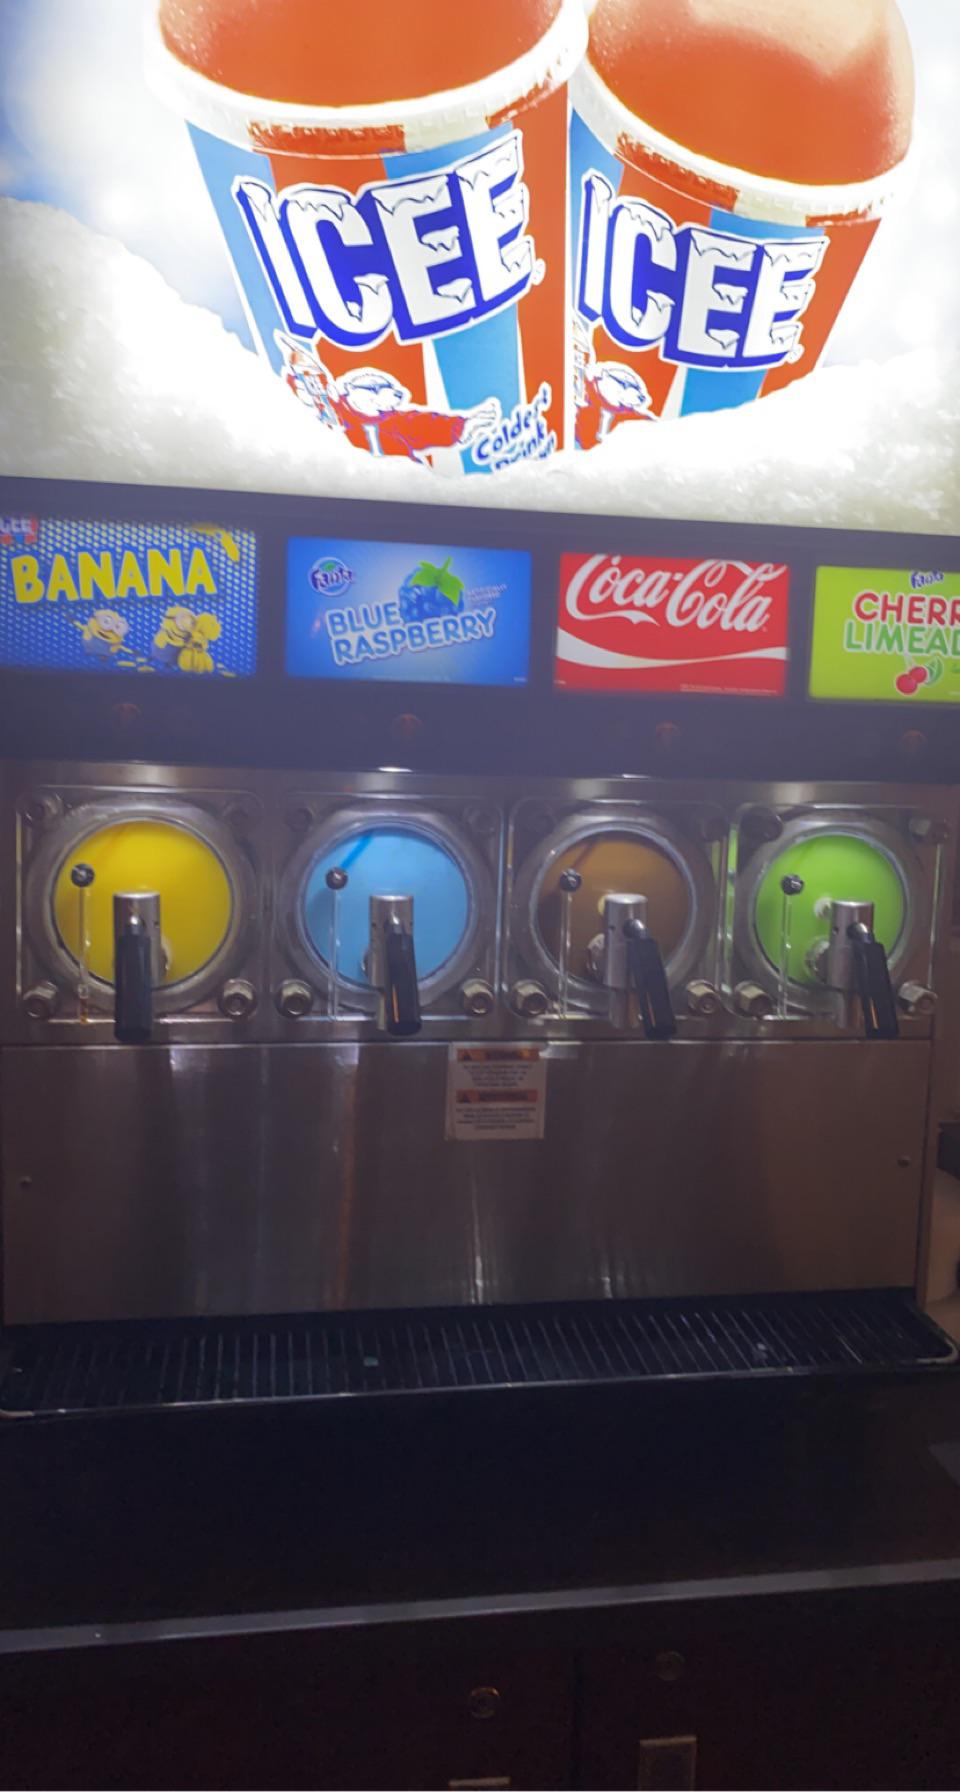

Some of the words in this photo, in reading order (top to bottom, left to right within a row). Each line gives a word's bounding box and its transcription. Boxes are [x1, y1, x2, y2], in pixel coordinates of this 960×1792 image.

[235, 133, 533, 346] ICEE
[577, 174, 825, 367] ICEE
[11, 548, 217, 603] BANANA
[310, 567, 355, 591] Fanta
[566, 554, 787, 632] Coca-Cola
[326, 602, 401, 637] BLUE
[331, 608, 495, 665] RASPBERRY
